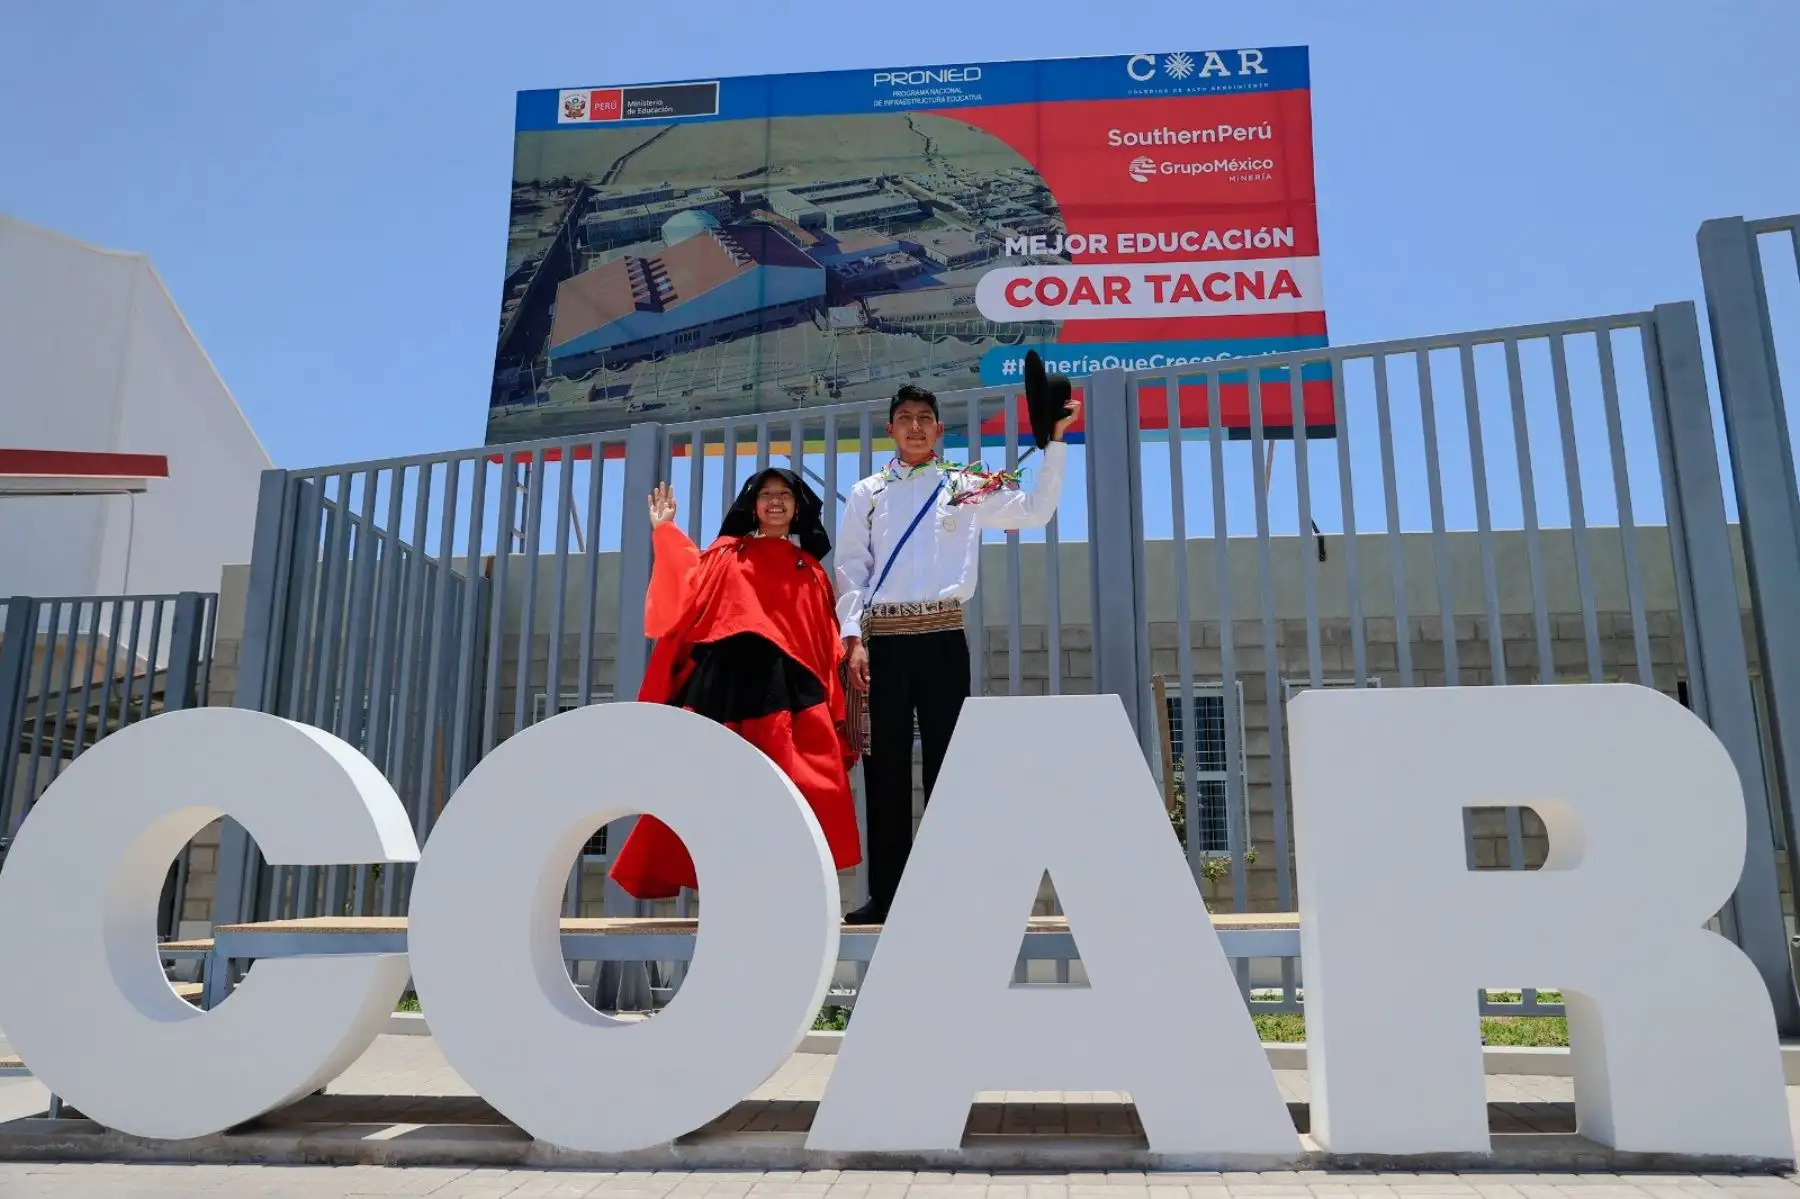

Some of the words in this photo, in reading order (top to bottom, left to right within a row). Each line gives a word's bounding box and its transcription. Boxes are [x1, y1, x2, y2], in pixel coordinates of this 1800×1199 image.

[1126, 49, 1269, 82] CAR
[873, 67, 981, 87] PRONIED
[873, 99, 883, 107] DE
[884, 96, 946, 106] INFRAESTRUCTURA
[947, 94, 982, 103] EDUCATIVA
[892, 89, 929, 97] PROGRAMA
[930, 87, 962, 95] NACIONAL
[594, 101, 617, 111] PERÚ
[627, 99, 663, 107] Ministerio
[627, 106, 635, 115] de
[637, 105, 674, 114] Educación
[1107, 121, 1272, 147] SouthernPerú
[1160, 157, 1273, 176] GrupoMéxico
[1005, 233, 1108, 257] MEJOR
[1005, 276, 1132, 308] COAR
[1144, 269, 1303, 303] TACNA
[0, 683, 1789, 1160] COAR
